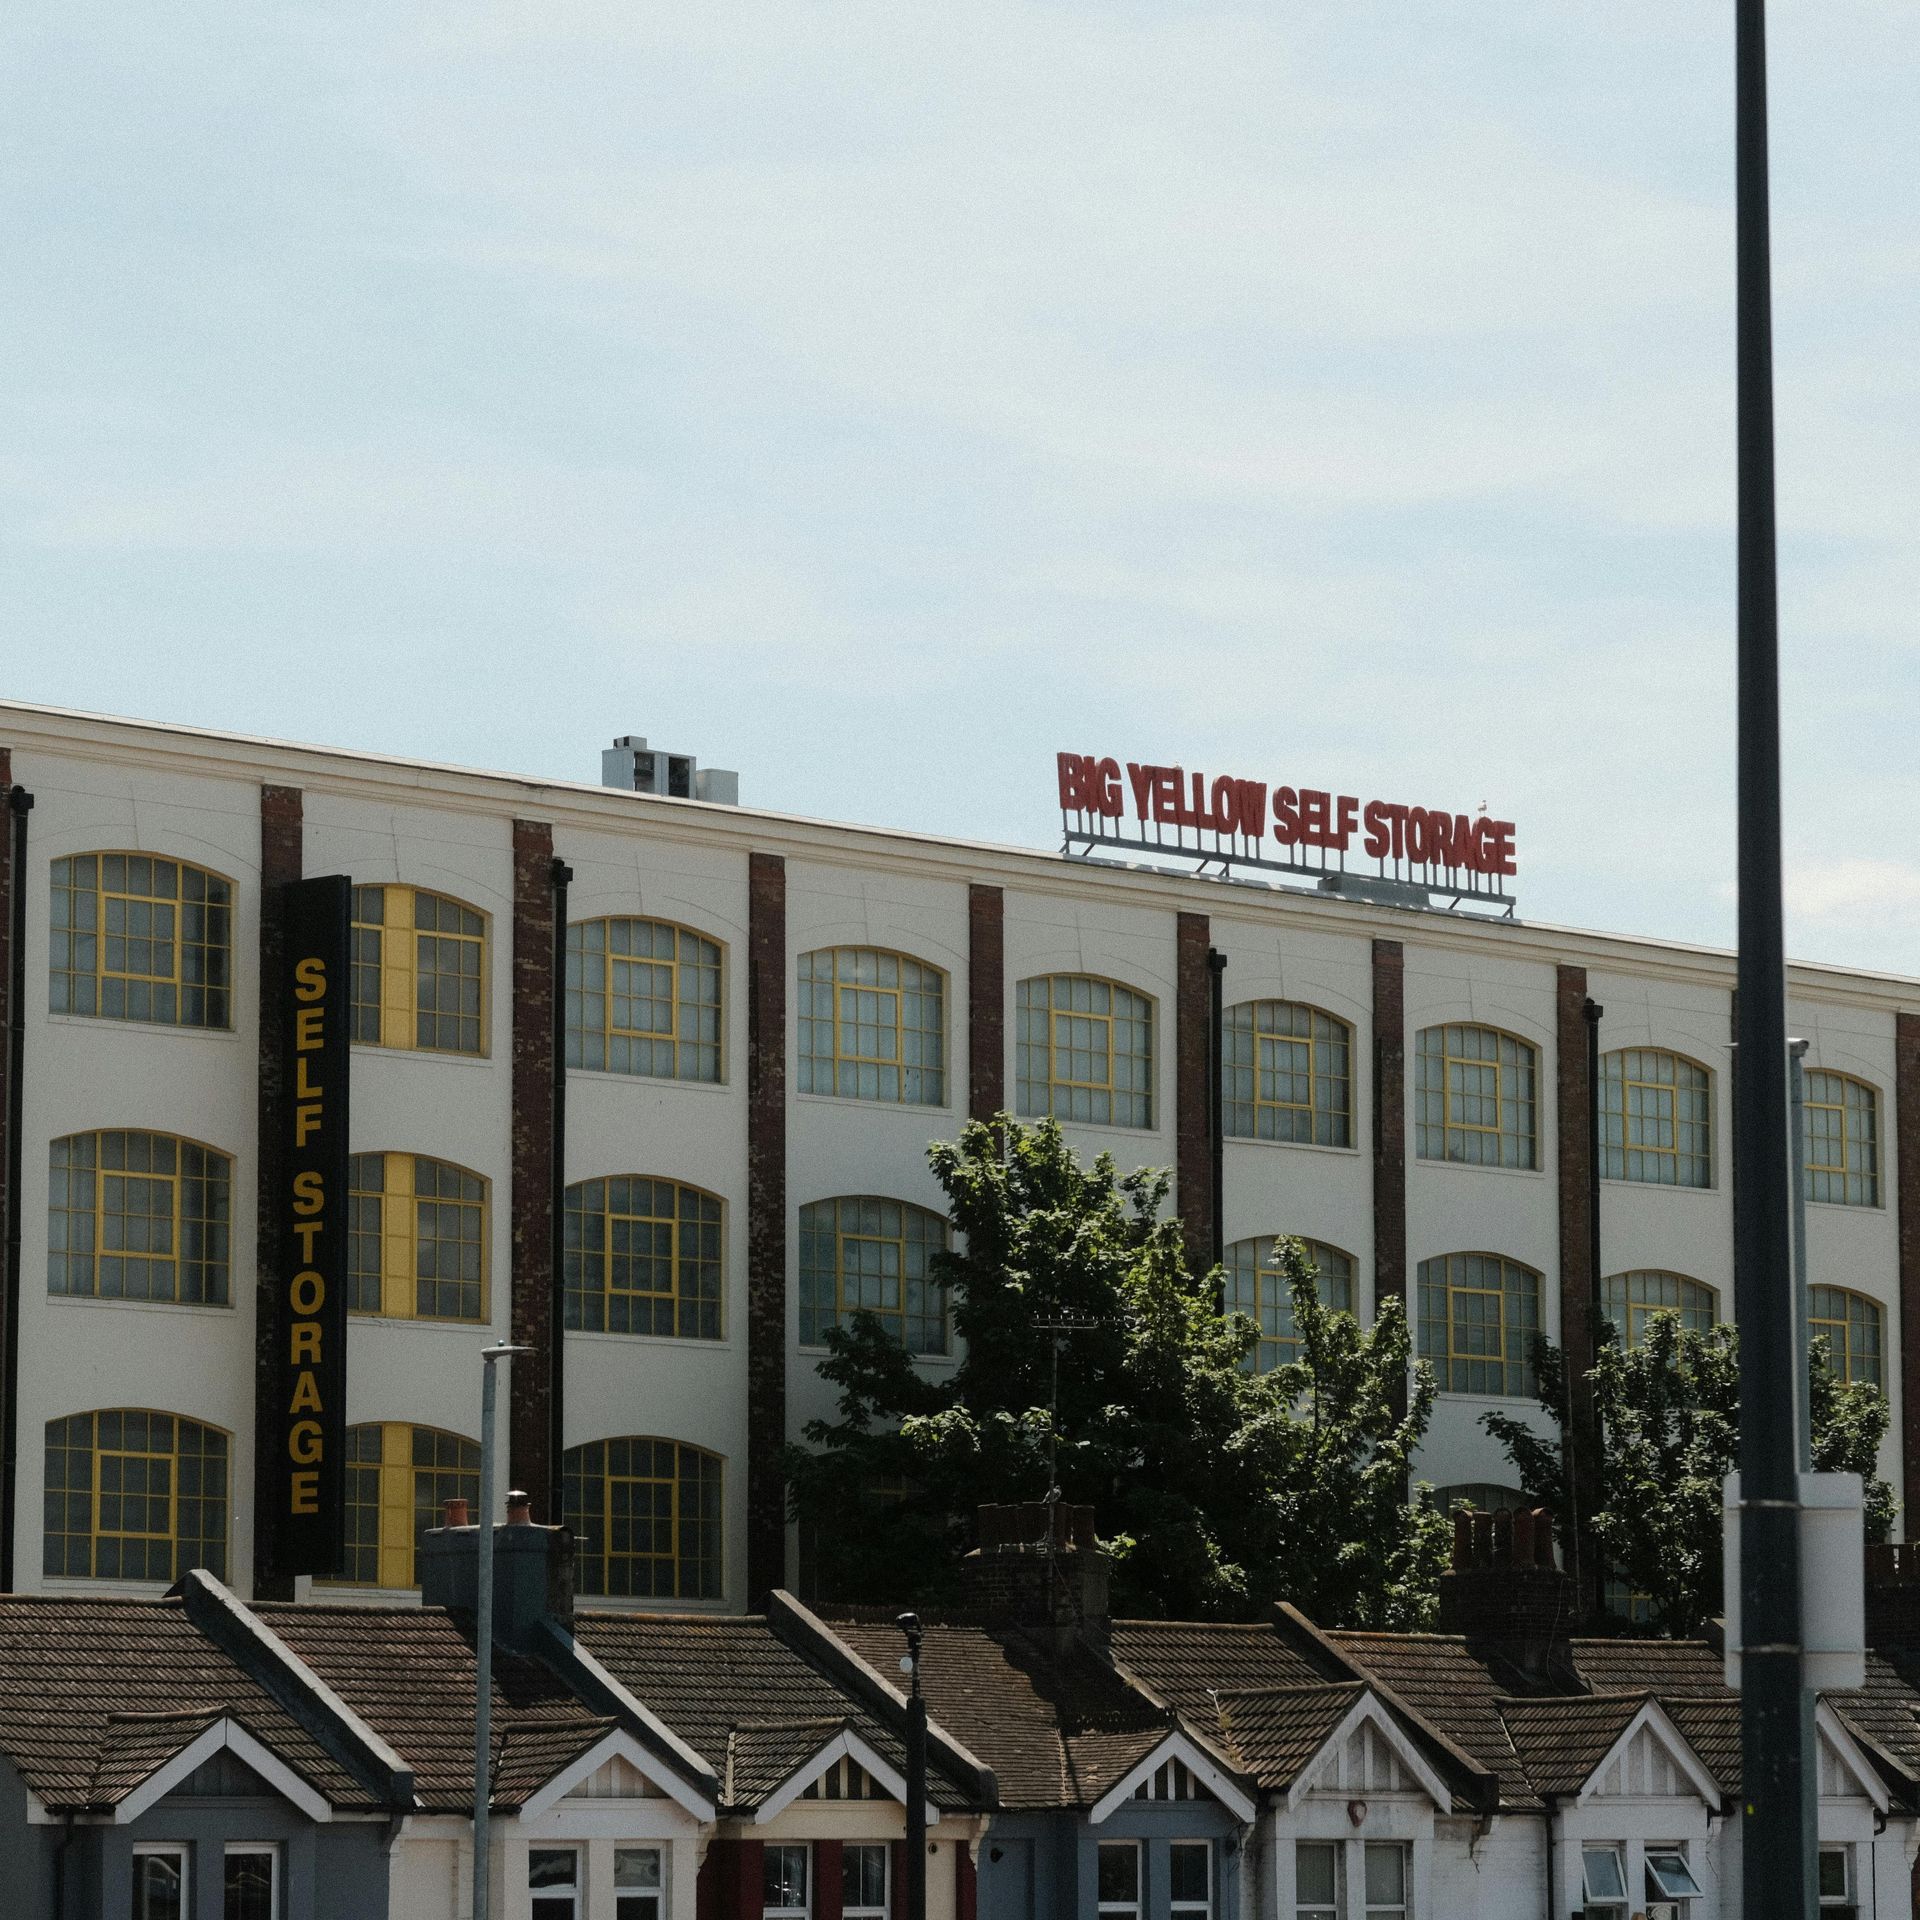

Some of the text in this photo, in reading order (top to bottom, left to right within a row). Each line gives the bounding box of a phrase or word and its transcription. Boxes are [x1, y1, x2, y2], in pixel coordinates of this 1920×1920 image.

[1057, 752, 1516, 876] BIG YELLOW SELF STORAGE
[288, 957, 326, 1514] SELF STORAGE
